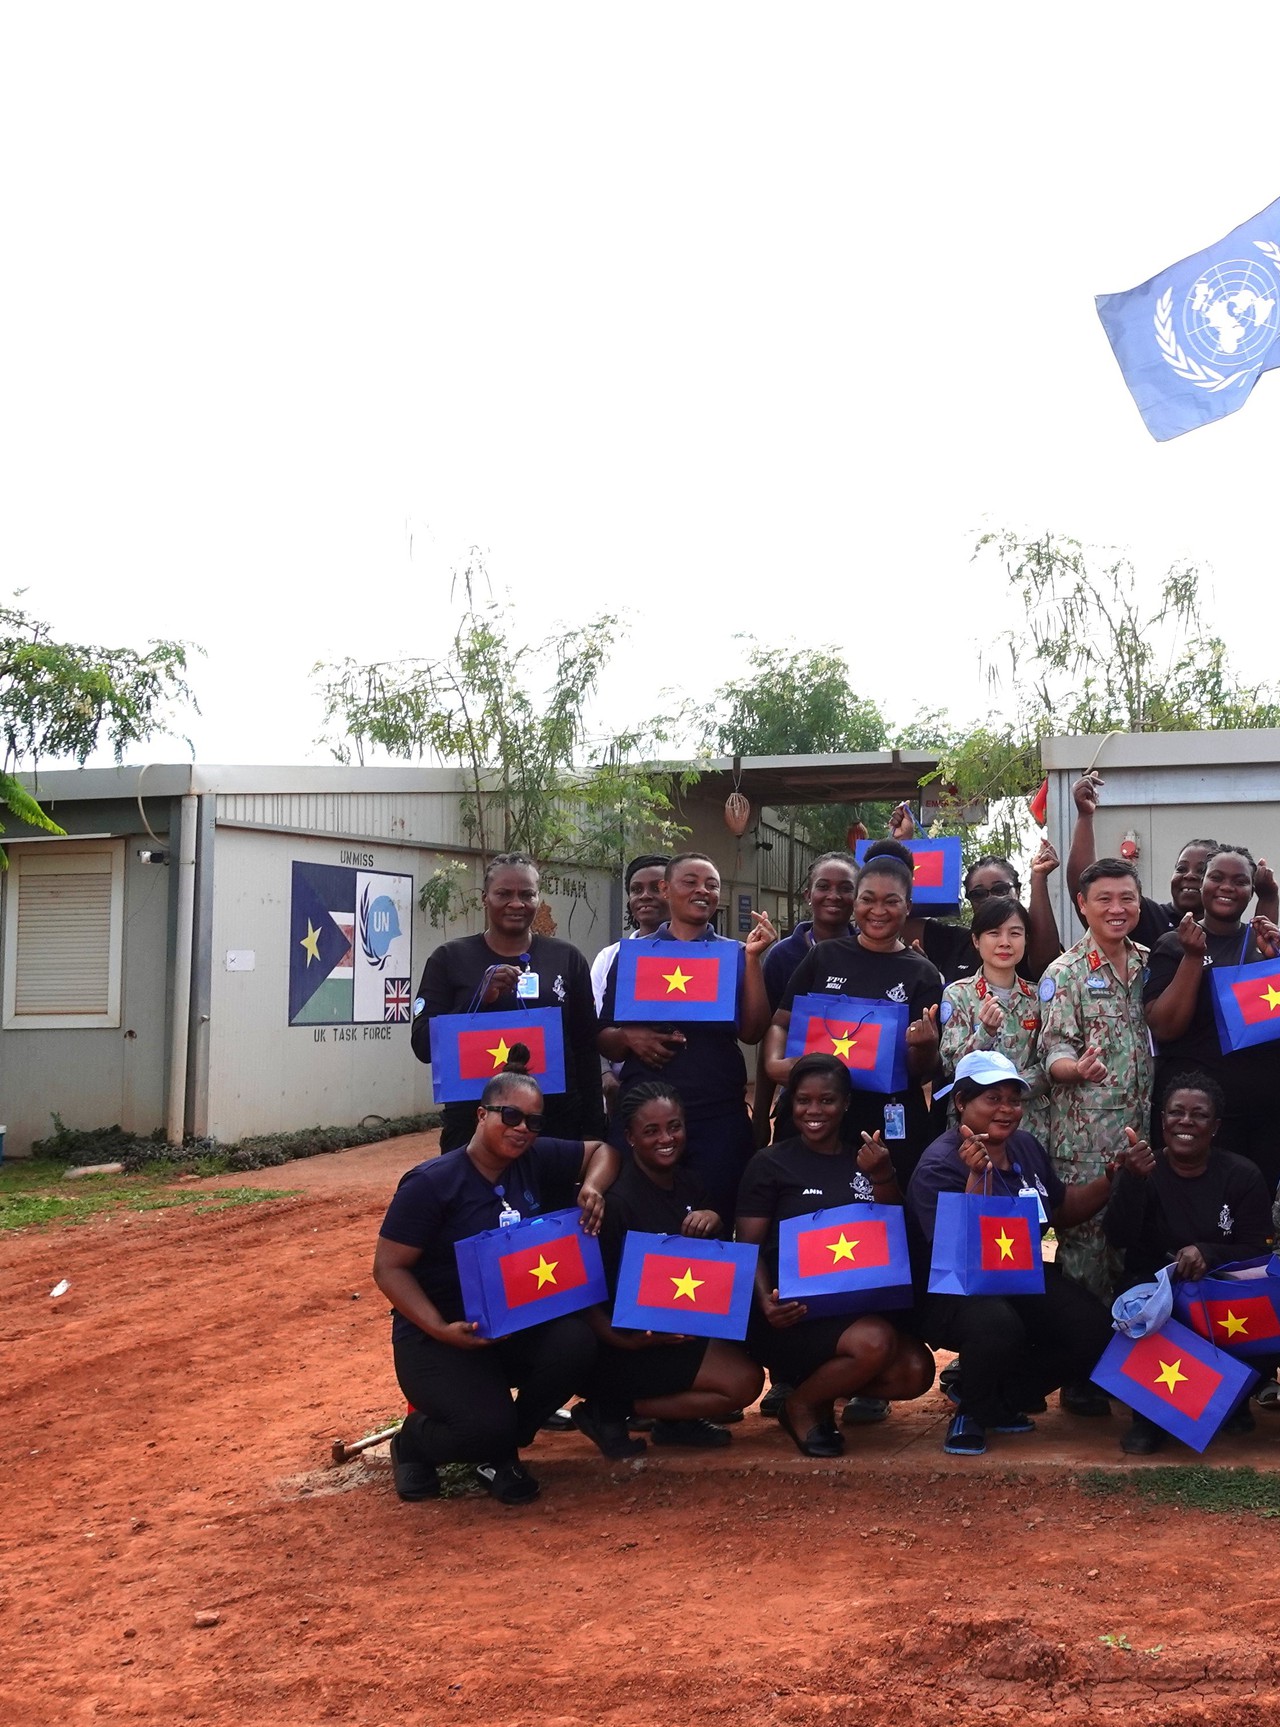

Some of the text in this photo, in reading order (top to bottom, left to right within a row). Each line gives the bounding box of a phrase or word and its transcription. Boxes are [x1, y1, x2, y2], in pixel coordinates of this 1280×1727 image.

[340, 850, 374, 867] UNMISS
[373, 911, 390, 932] UN
[826, 975, 848, 984] FPU
[313, 1026, 392, 1042] UK TASK FORCE
